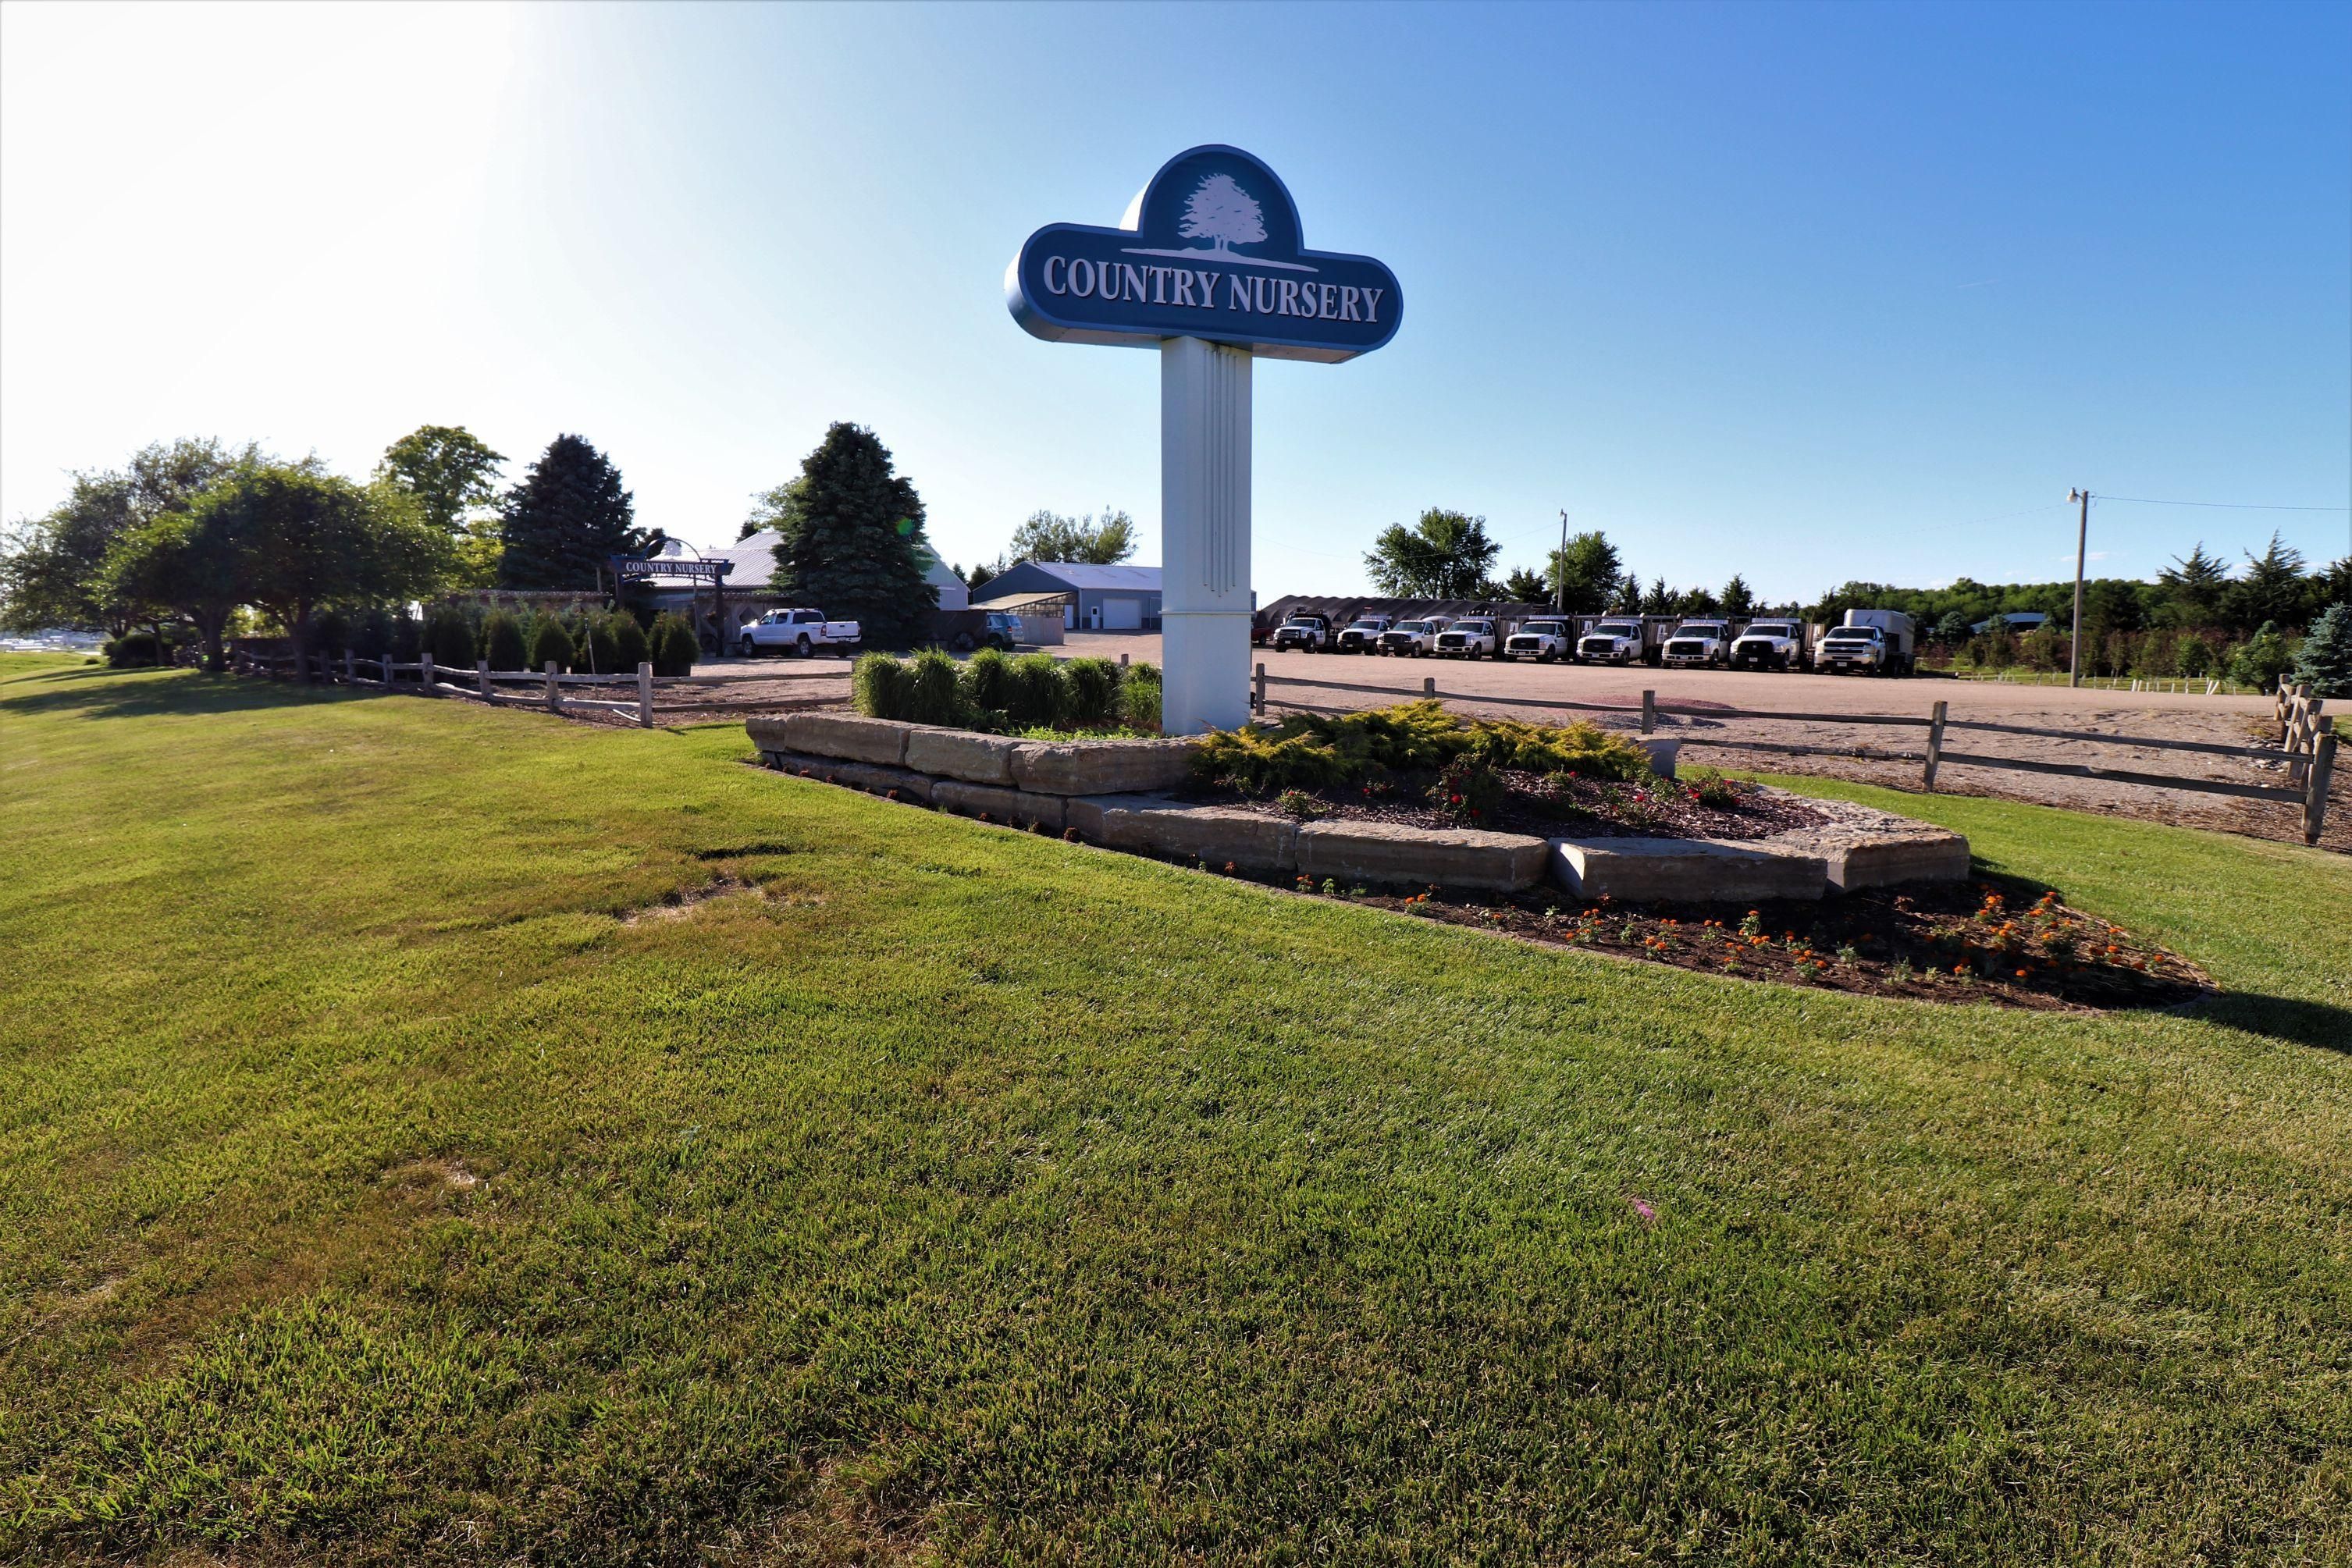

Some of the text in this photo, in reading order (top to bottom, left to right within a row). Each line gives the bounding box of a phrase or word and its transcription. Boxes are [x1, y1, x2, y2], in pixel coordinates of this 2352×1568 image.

[1043, 255, 1384, 324] COUNTRY NURSERY
[626, 561, 717, 574] COUNTRY NURSERY
